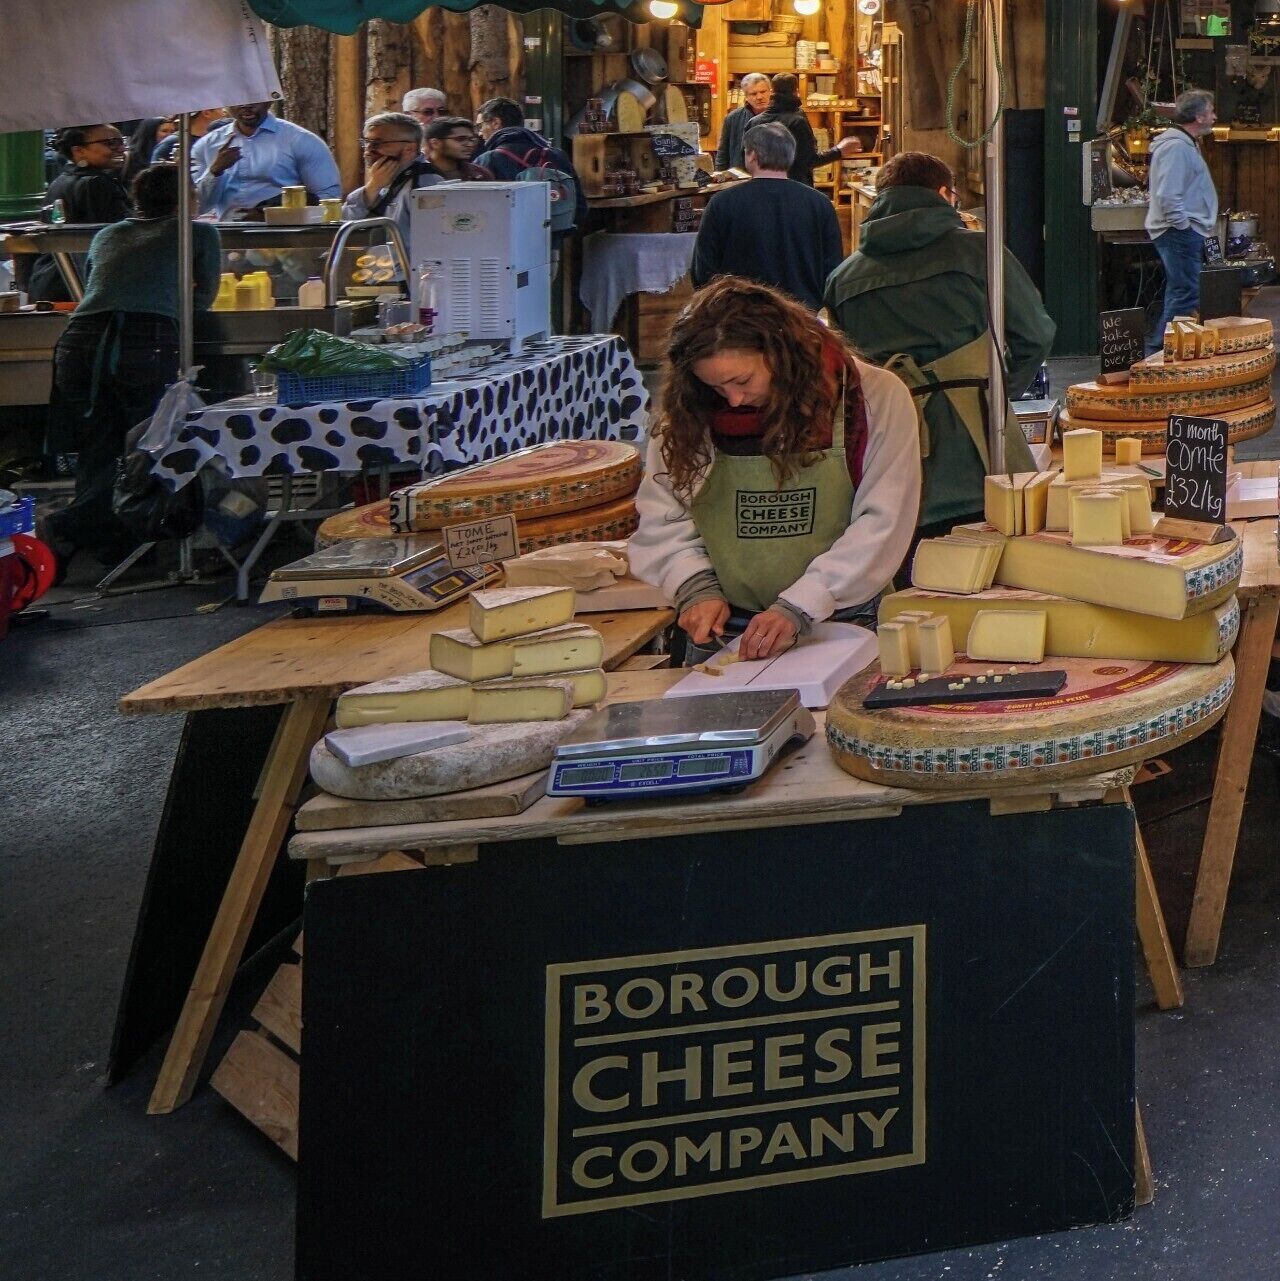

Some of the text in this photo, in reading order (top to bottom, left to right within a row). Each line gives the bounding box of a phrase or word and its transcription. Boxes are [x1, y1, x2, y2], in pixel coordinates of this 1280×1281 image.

[1103, 317, 1121, 329] We
[1102, 329, 1130, 342] take
[1105, 354, 1126, 367] over
[1169, 418, 1224, 449] 15 month
[740, 492, 811, 504] BOROUGH
[1166, 473, 1222, 518] £32/kg
[740, 506, 810, 521] CHEESE
[452, 523, 495, 540] TOME
[740, 523, 808, 535] COMPANY
[574, 949, 902, 1026] BOROUGH
[572, 1021, 902, 1114] CHEESE
[571, 1107, 900, 1190] COMPANY
